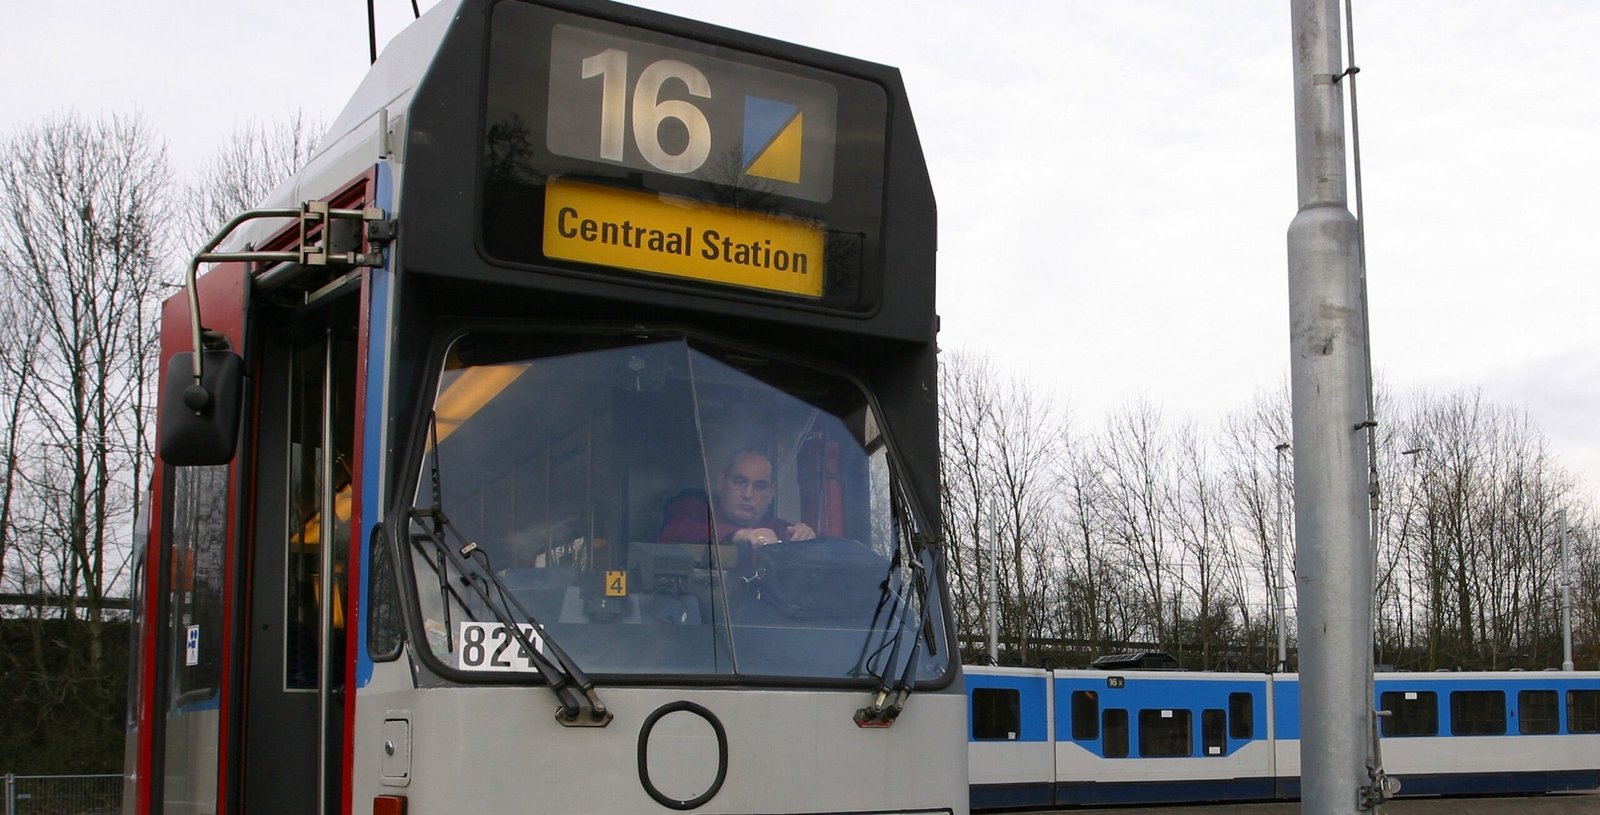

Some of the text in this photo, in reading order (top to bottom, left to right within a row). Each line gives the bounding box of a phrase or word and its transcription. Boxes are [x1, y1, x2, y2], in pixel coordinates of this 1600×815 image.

[581, 48, 712, 174] 16
[557, 206, 808, 275] Centraal Station
[610, 577, 623, 594] 4
